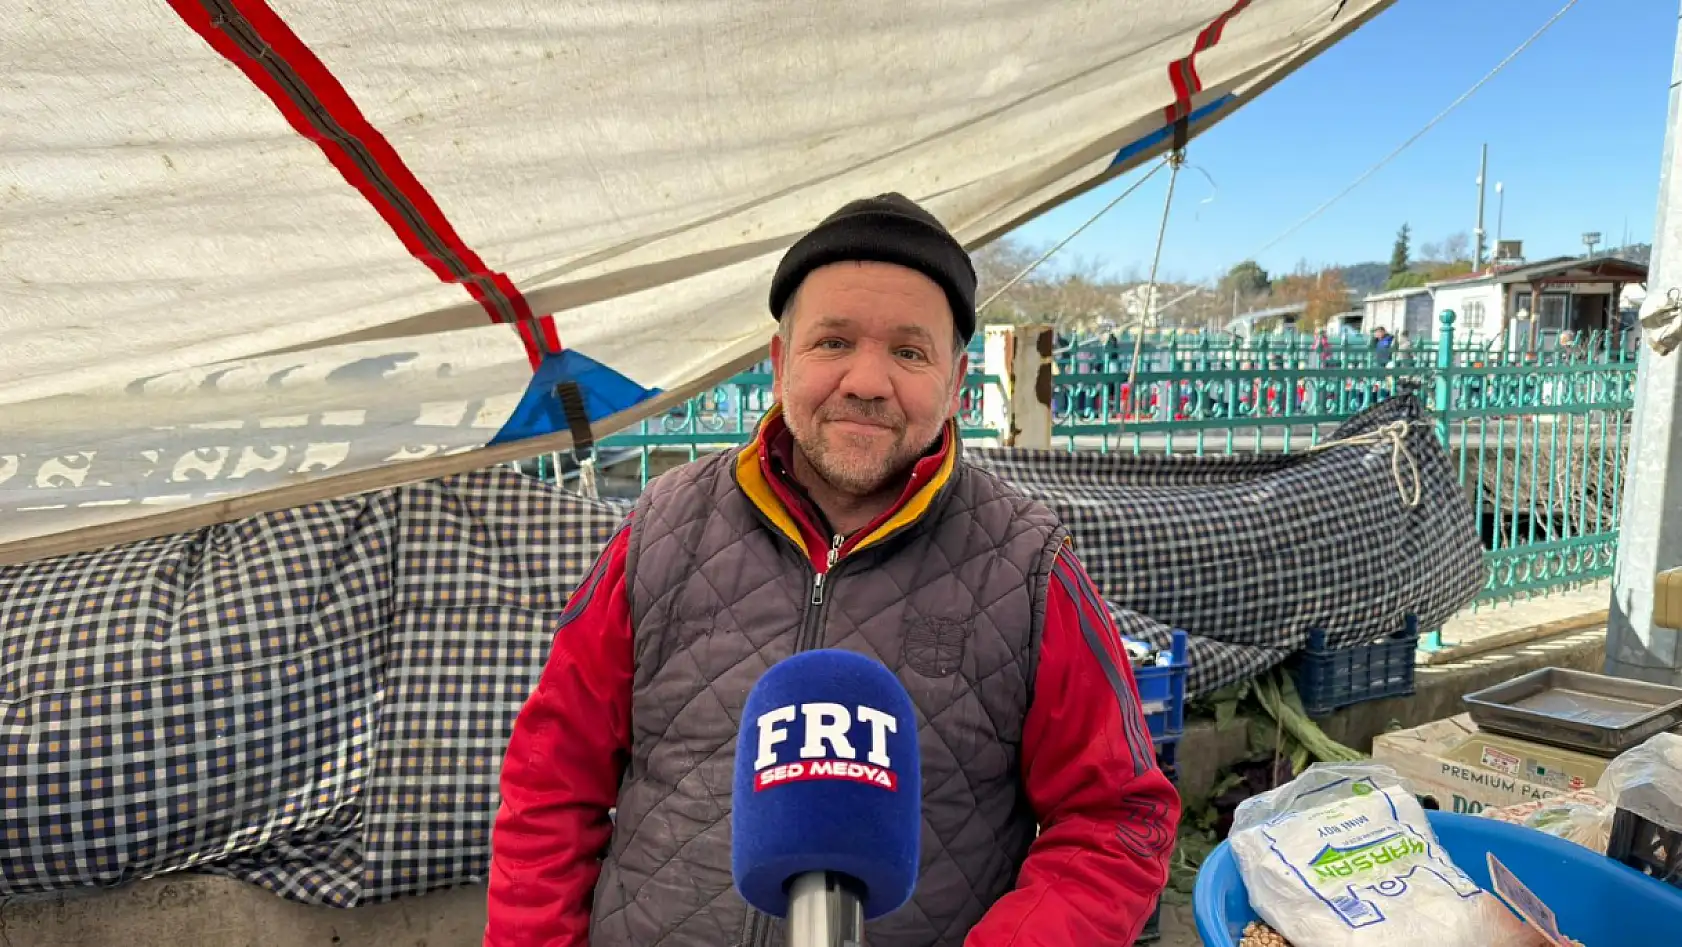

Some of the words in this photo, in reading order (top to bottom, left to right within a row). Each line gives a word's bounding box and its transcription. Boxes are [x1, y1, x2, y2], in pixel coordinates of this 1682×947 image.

[754, 703, 897, 770] FRT
[760, 764, 804, 785] SED
[809, 761, 892, 787] MEDYA
[1441, 763, 1516, 793] PREMIUM
[1521, 783, 1557, 800] PAC
[1314, 837, 1425, 879] KARSAN
